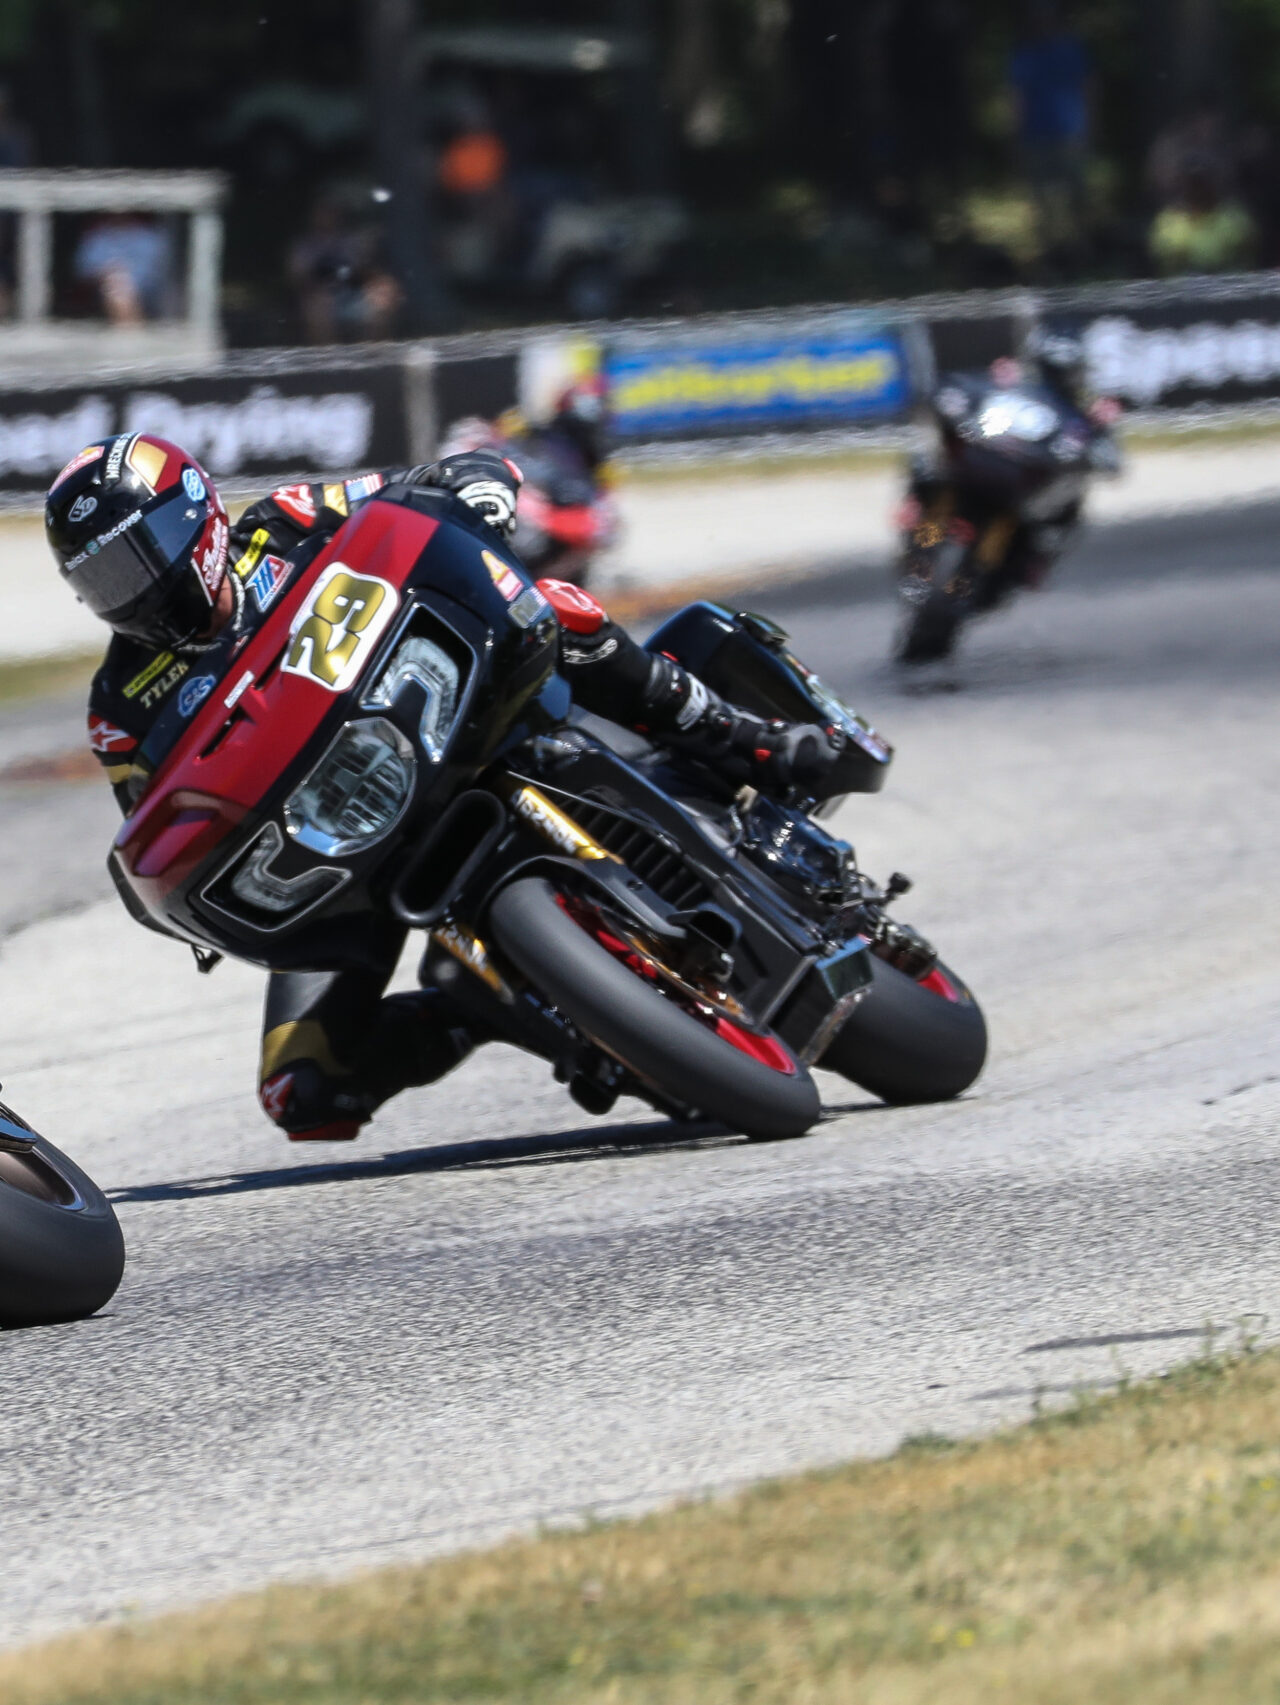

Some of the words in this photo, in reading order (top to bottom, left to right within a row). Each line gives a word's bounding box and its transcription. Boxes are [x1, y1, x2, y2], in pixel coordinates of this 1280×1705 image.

[1082, 315, 1280, 402] Spee
[96, 508, 143, 547] Recover
[287, 572, 387, 687] 29
[139, 660, 190, 709] TYLER
